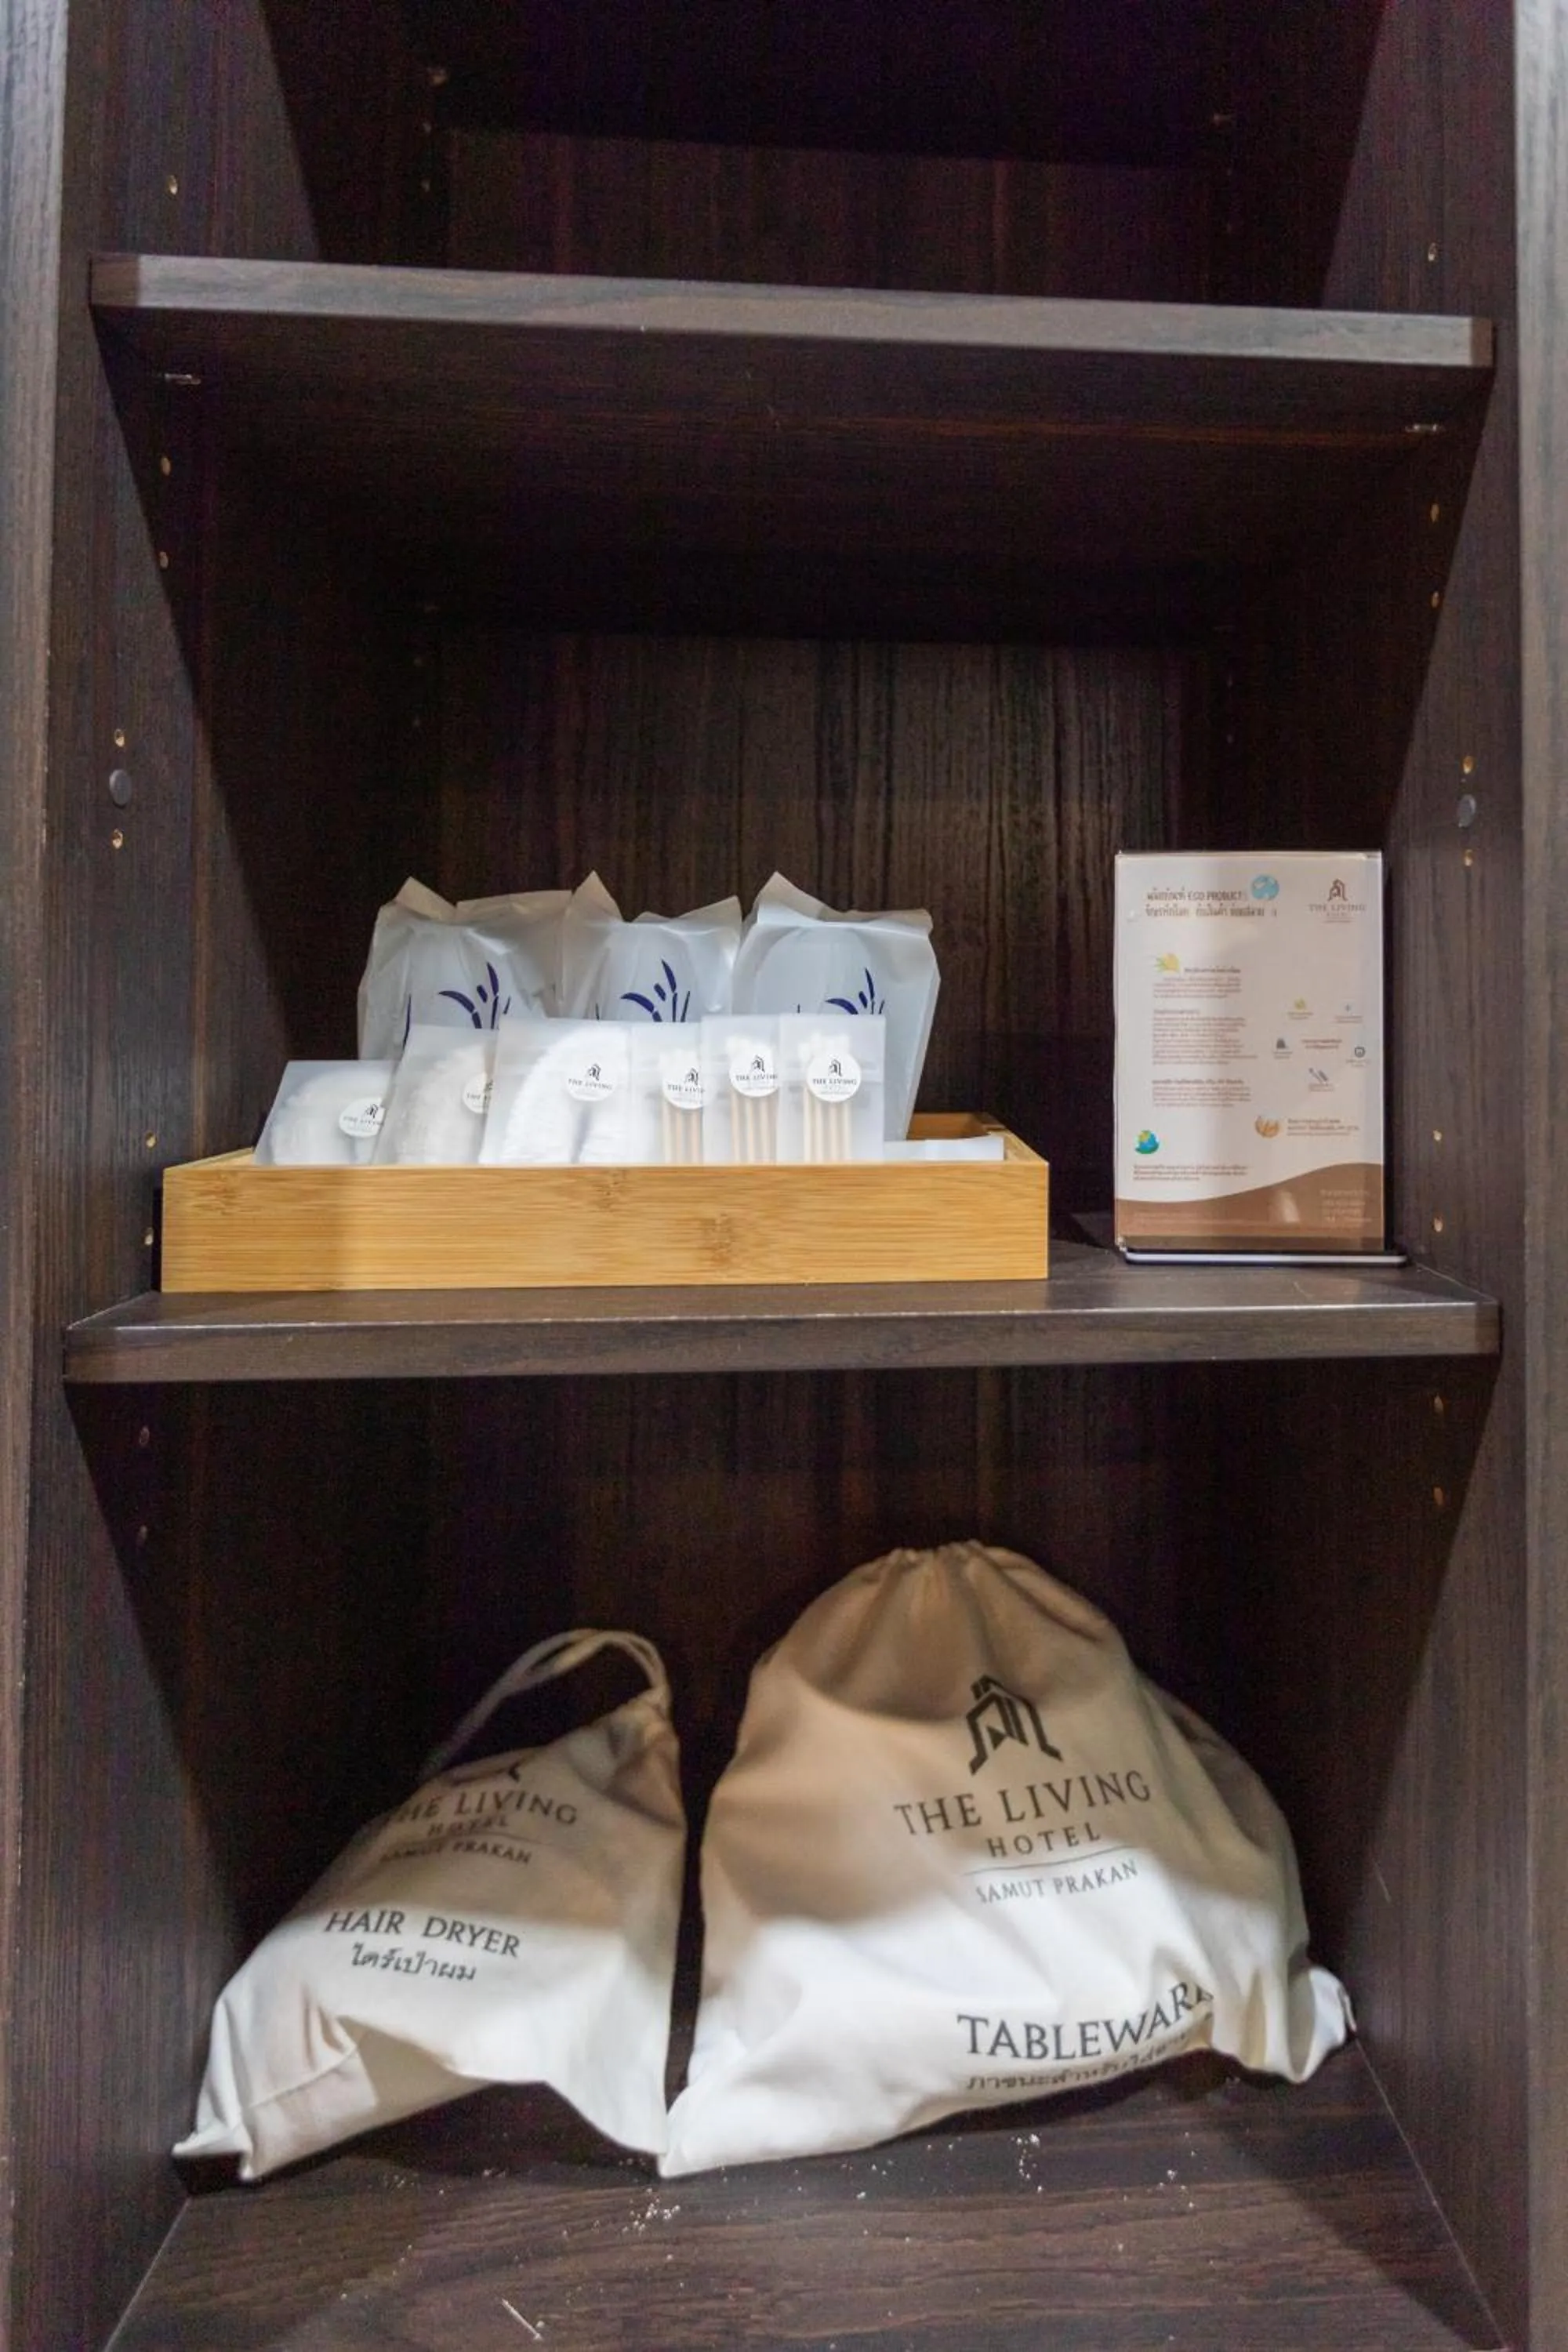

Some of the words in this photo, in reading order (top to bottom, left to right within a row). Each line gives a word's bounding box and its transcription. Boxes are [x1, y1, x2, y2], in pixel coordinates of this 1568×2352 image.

[454, 1790, 577, 1826] LIVING
[895, 1793, 982, 1835] THE
[998, 1770, 1151, 1824] LIVING
[452, 1842, 532, 1866] PRAKAN
[988, 1821, 1102, 1858] HOTEL
[976, 1880, 1046, 1904] SAMUT
[1054, 1860, 1138, 1894] PRAKAN
[324, 1909, 406, 1935] HAIR
[422, 1915, 521, 1958] DRYER
